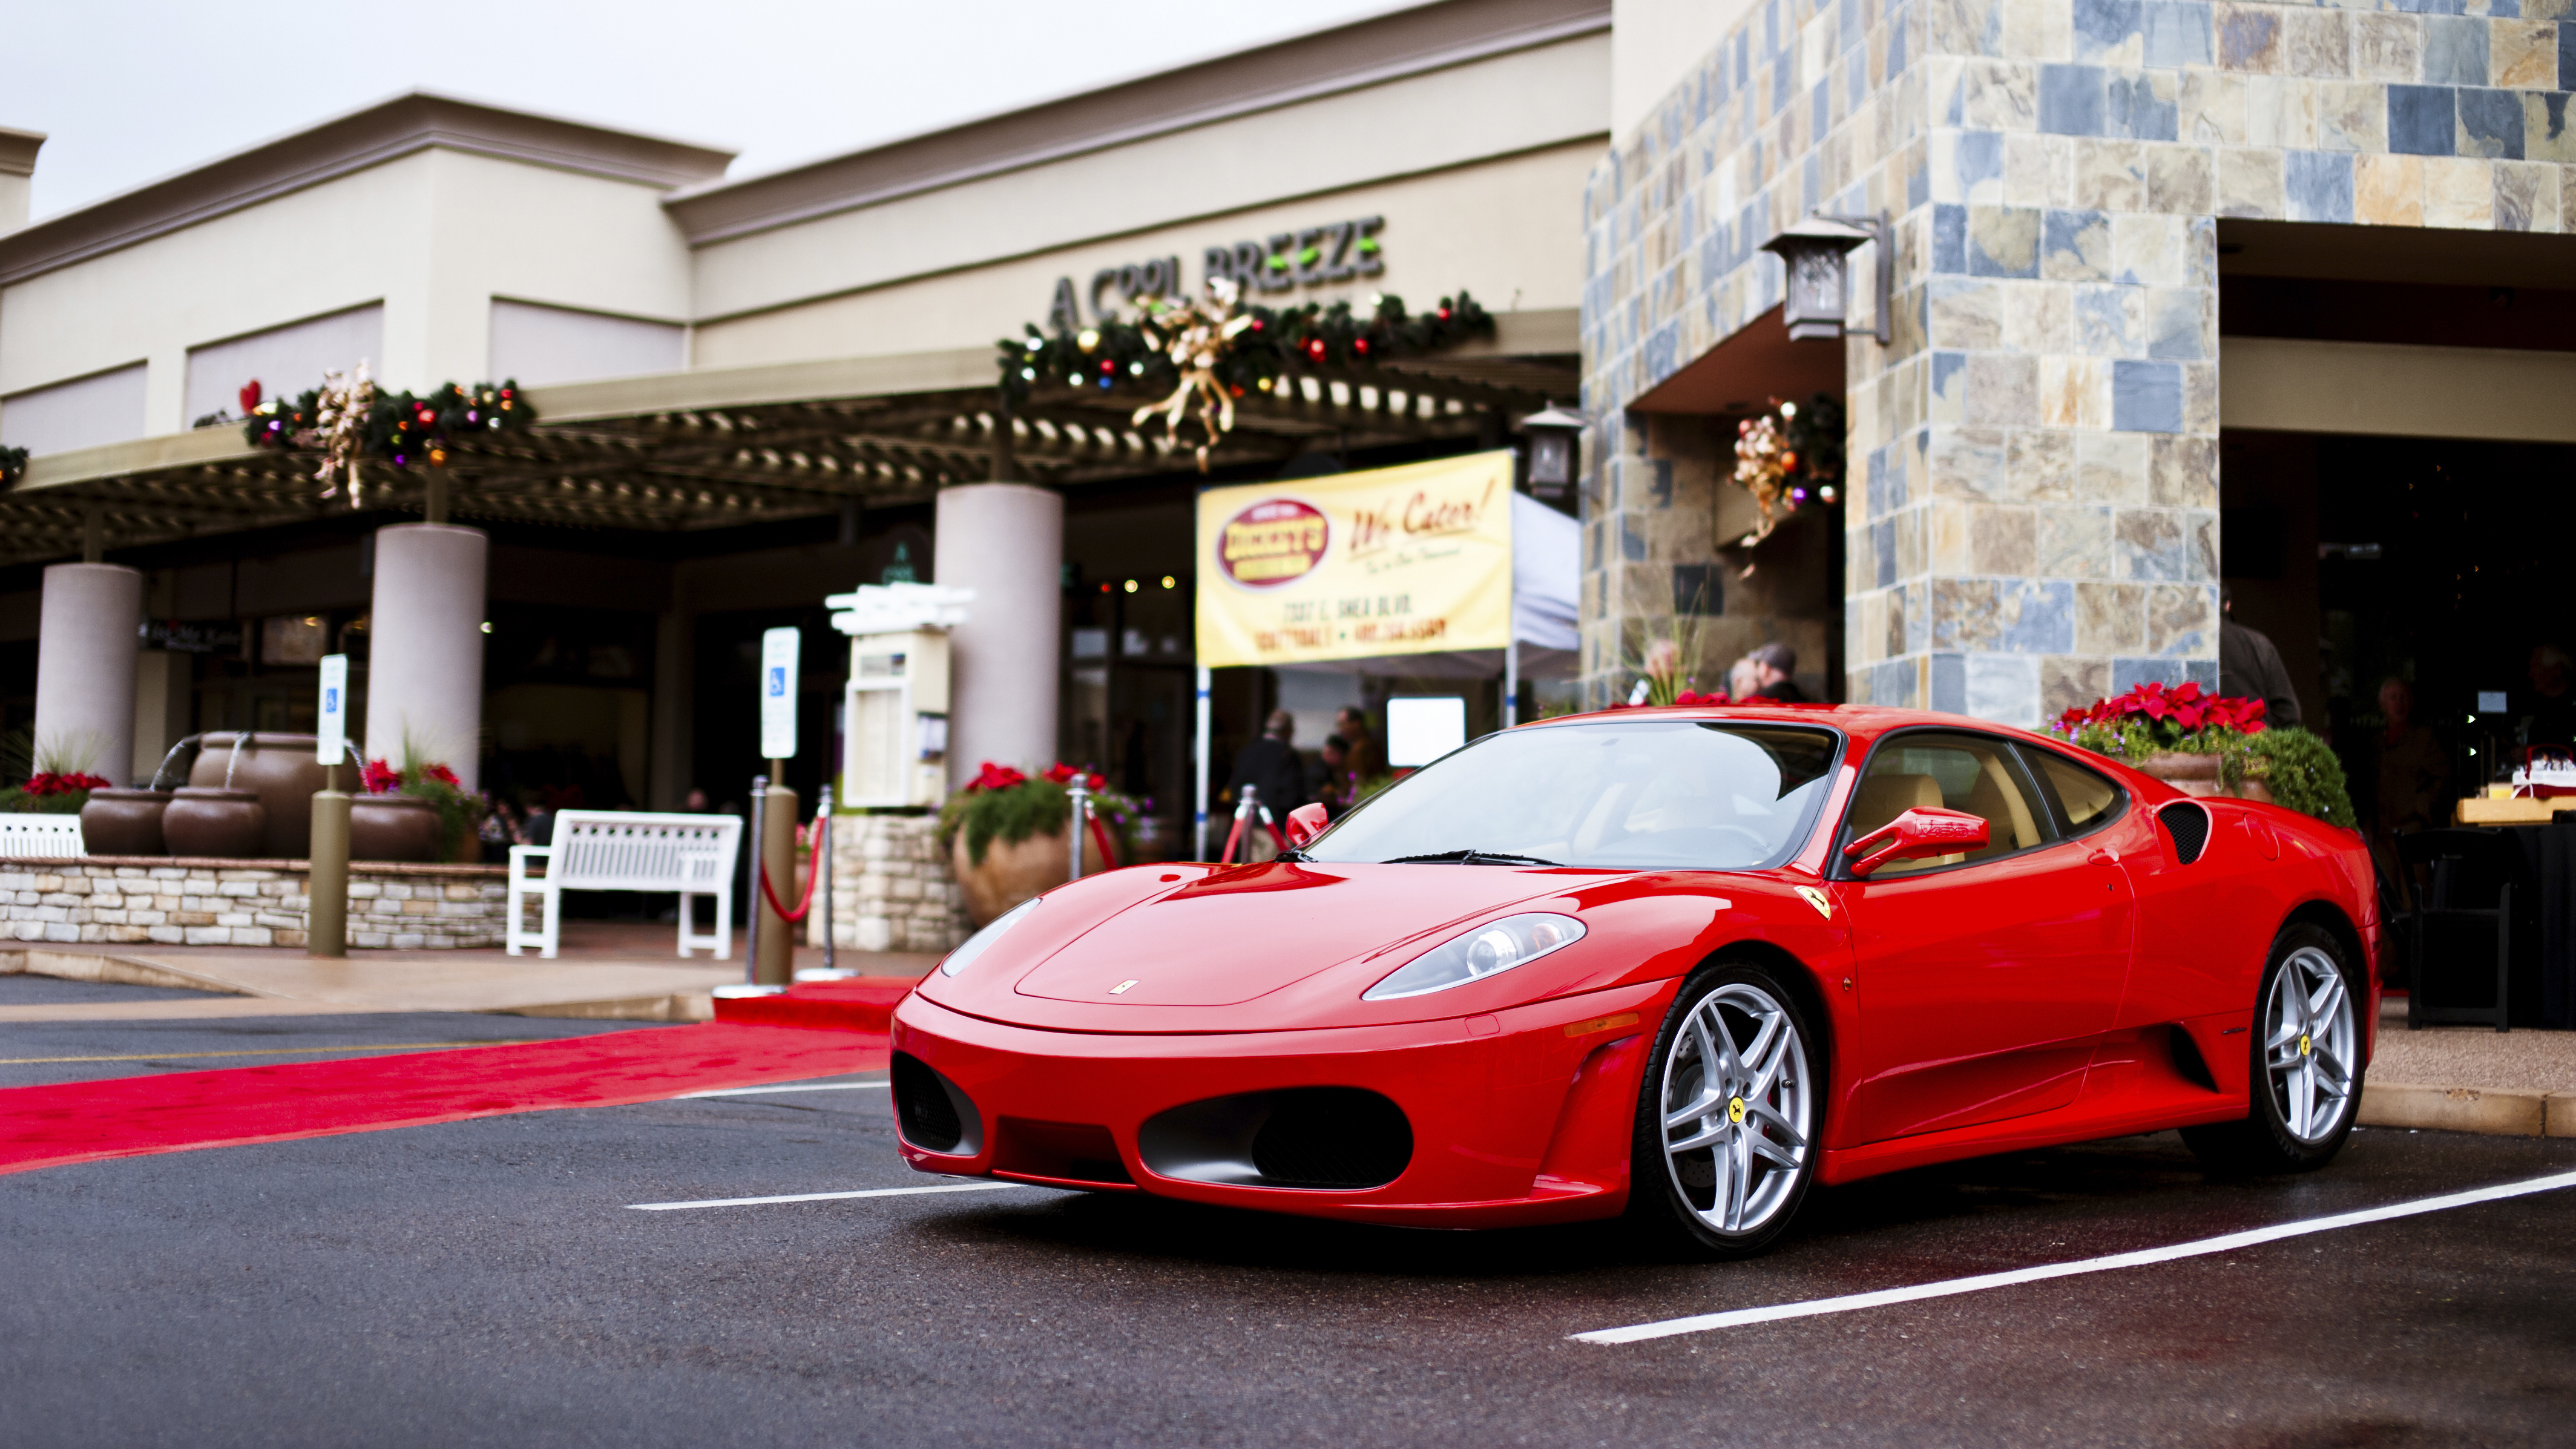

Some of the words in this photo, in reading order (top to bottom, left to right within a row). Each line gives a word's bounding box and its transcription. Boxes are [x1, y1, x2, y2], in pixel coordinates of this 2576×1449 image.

[1048, 276, 1080, 327] A
[1089, 255, 1191, 321] COOL
[1204, 215, 1384, 297] BREEZE
[1350, 498, 1391, 551] We
[1402, 478, 1495, 534] Cater!
